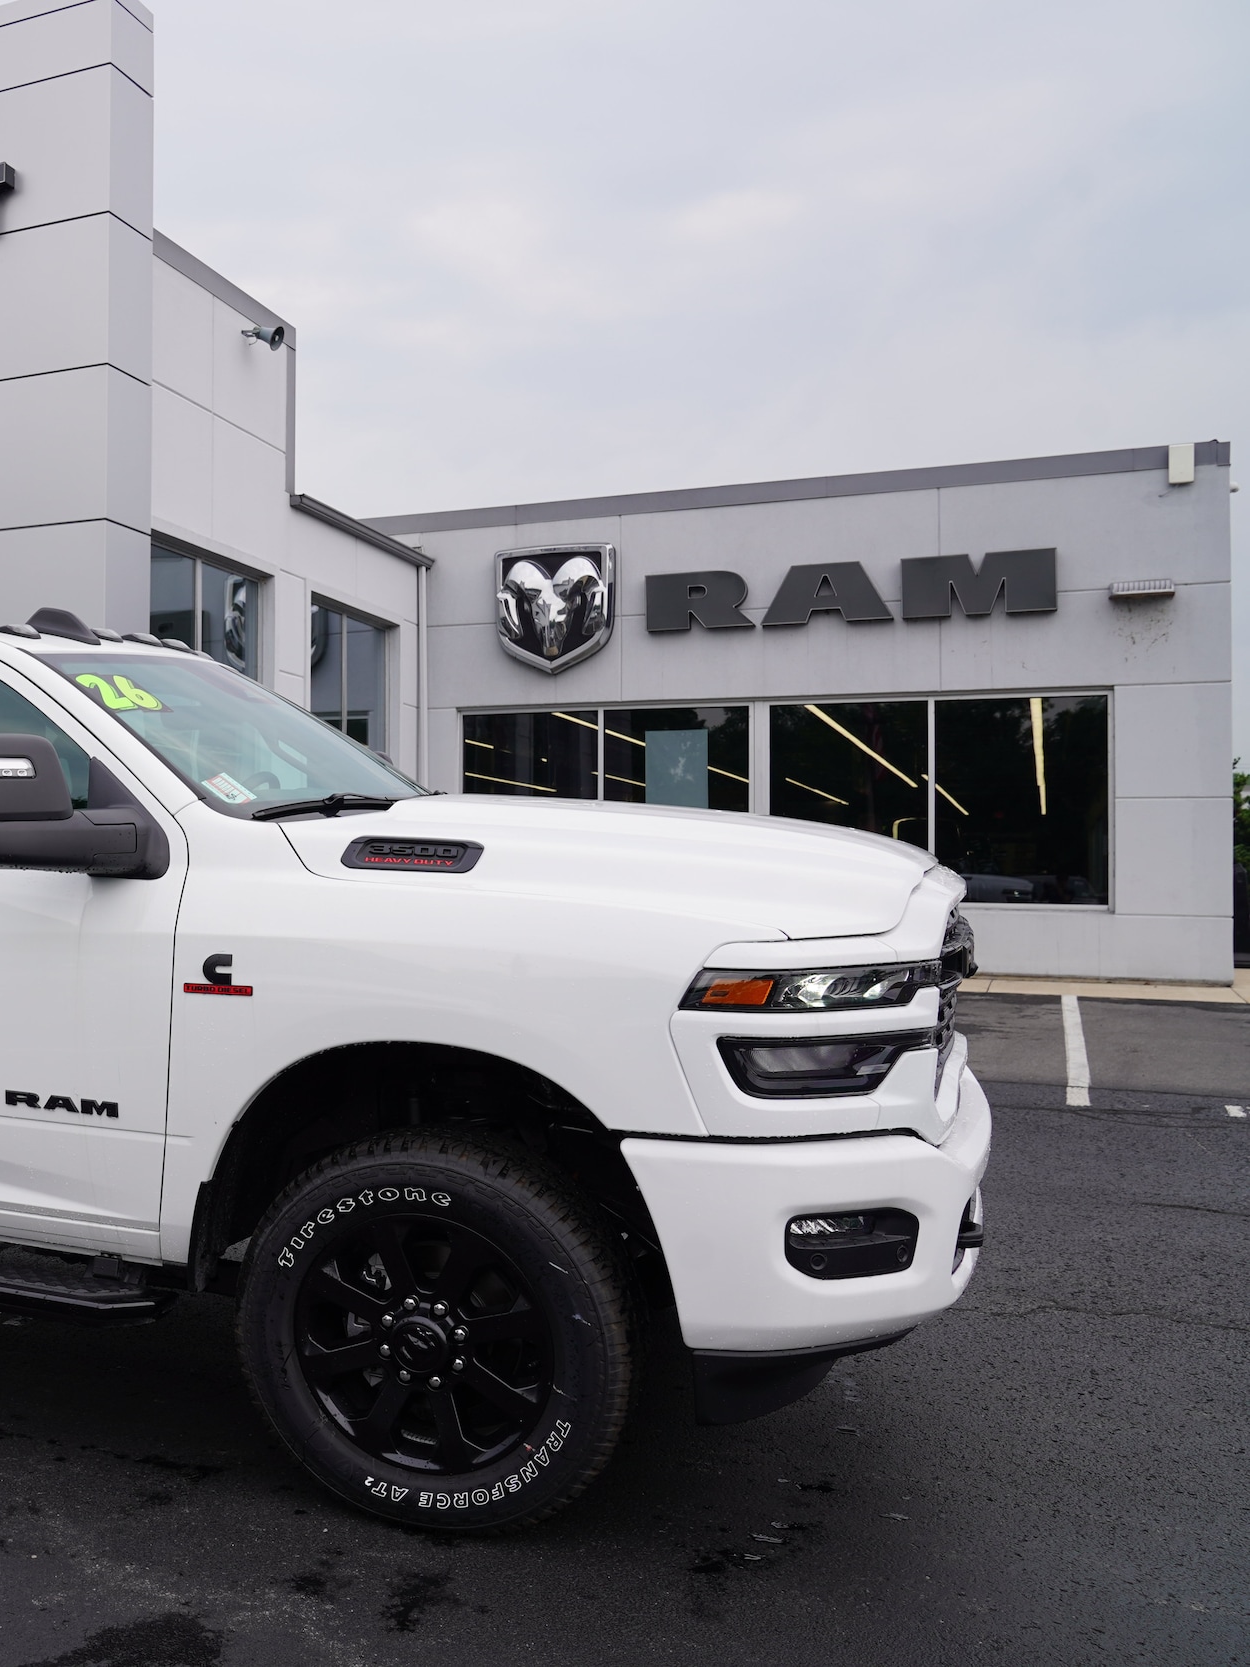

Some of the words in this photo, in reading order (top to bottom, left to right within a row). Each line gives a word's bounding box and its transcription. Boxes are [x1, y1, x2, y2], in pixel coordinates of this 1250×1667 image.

[644, 547, 1058, 634] RAM
[74, 673, 163, 711] 26
[363, 856, 411, 865] HEAVY
[413, 857, 455, 867] DUTY
[367, 844, 460, 859] 3500
[185, 984, 216, 993] TURBO
[217, 986, 249, 995] DIESEL
[4, 1089, 119, 1119] RAM
[277, 1187, 452, 1268] Firestone
[418, 1419, 573, 1510] TRANSFORCE
